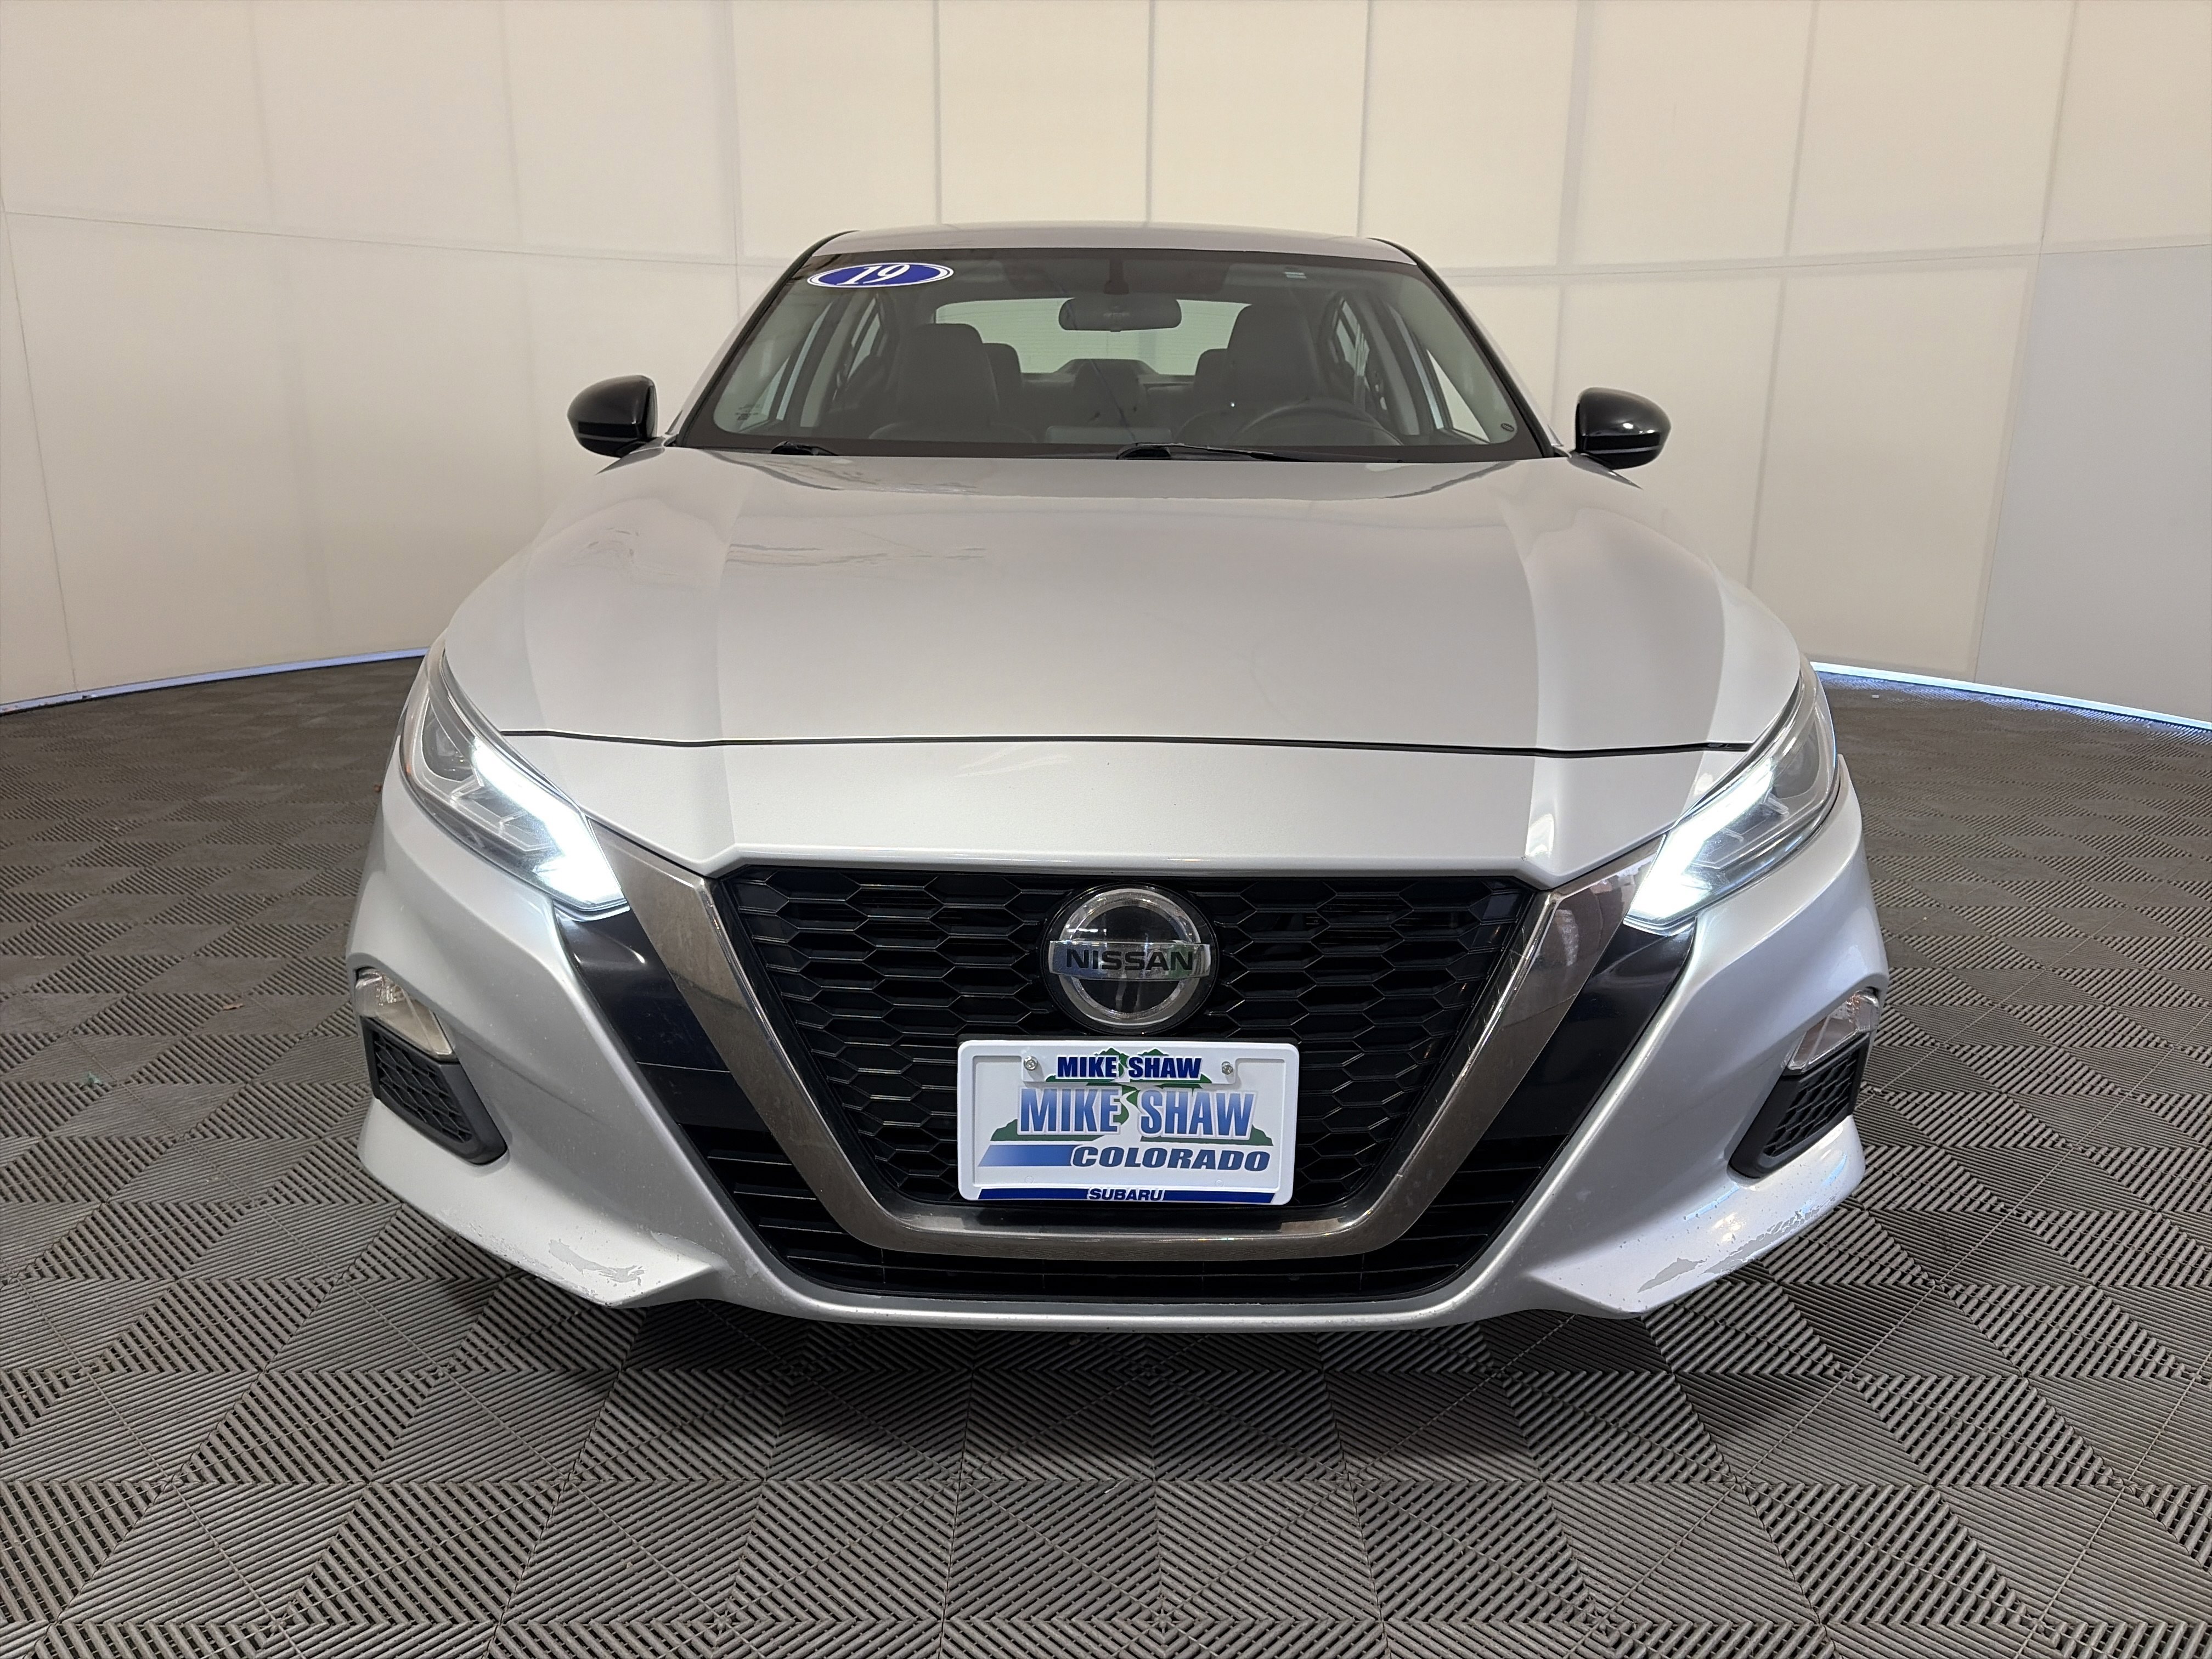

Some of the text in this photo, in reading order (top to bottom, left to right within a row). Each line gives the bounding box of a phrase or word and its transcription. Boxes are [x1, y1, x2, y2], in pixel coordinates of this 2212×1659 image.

[836, 264, 910, 285] 19
[1066, 949, 1193, 971] NISSAN
[1057, 1056, 1203, 1079] MIKE SHAW
[1019, 1088, 1255, 1137] MIKE SHAW
[1072, 1146, 1271, 1172] COLORADO
[1088, 1188, 1164, 1201] SUBARU
